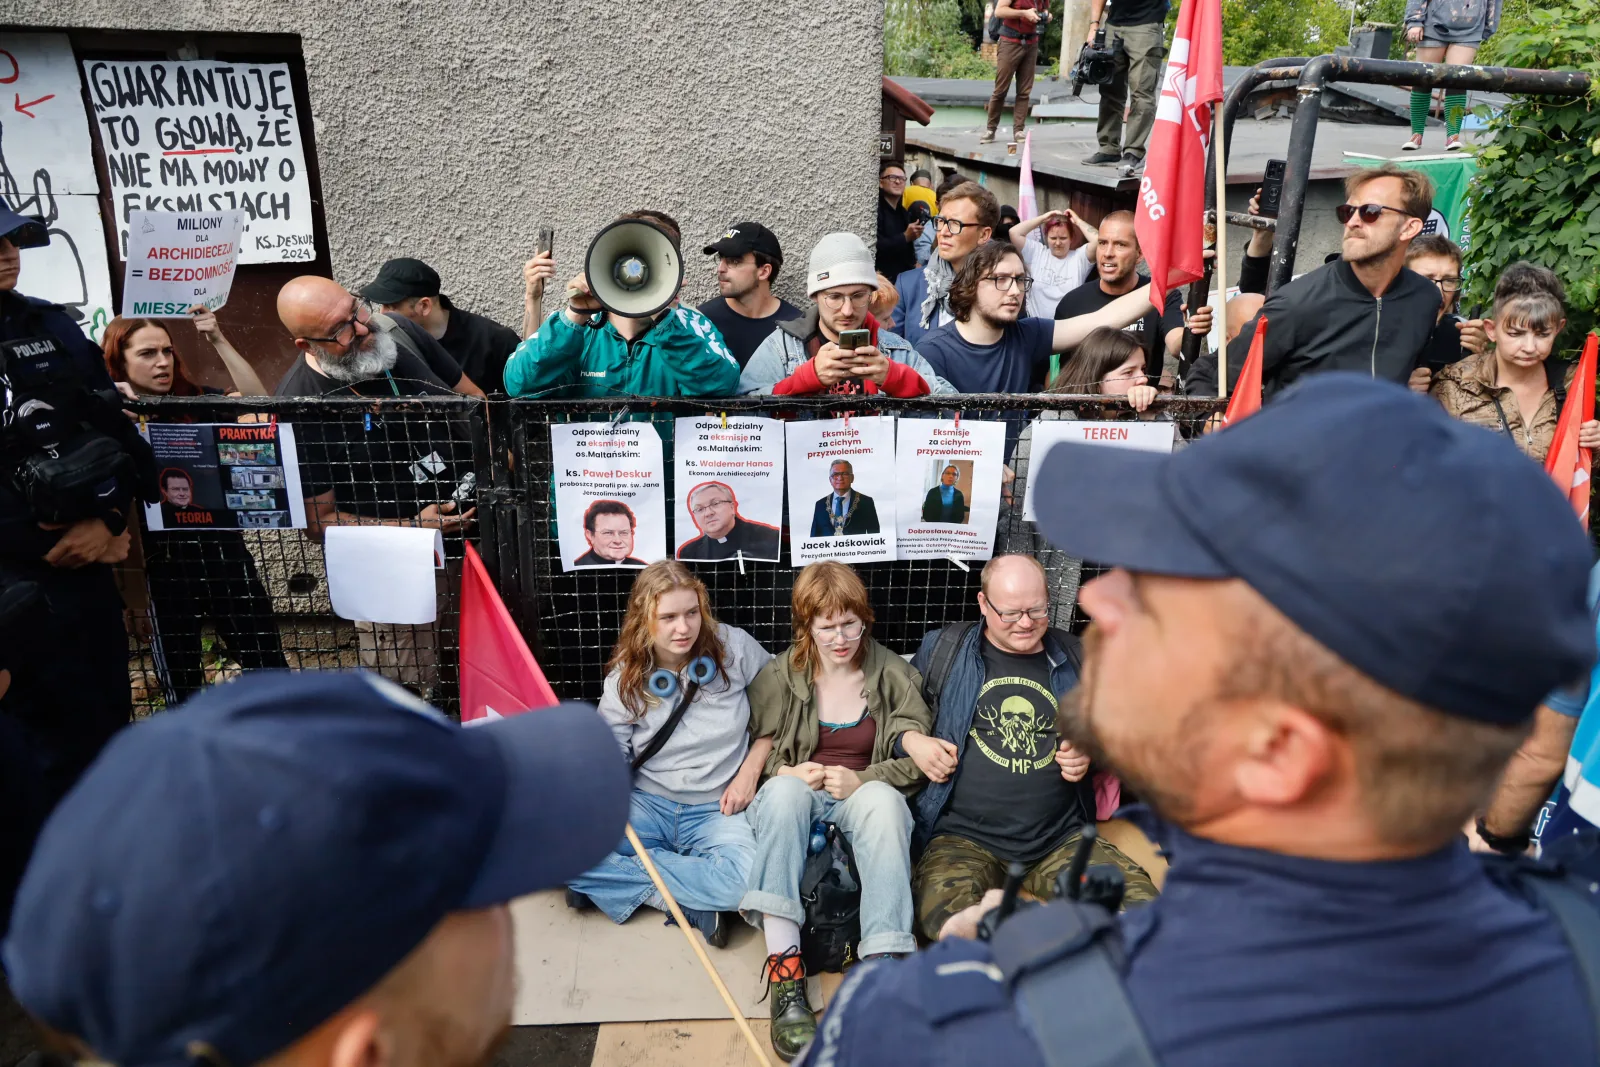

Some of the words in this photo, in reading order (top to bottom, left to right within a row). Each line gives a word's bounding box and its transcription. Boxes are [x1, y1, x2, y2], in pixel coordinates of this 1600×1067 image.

[101, 115, 140, 150] TO
[155, 112, 254, 154] GŁOWĄ,
[257, 114, 293, 147] ŻE
[108, 153, 152, 188] NIE
[160, 158, 198, 187] MA
[203, 156, 270, 186] MOWY
[279, 158, 296, 183] O
[177, 216, 223, 231] MILIONY
[195, 234, 209, 243] DLA
[280, 248, 311, 260] 2024
[148, 258, 235, 282] BEZDOMNOŚĆ
[193, 287, 207, 296] DLA
[12, 339, 57, 359] POLICJA
[580, 370, 606, 378] hummel
[219, 427, 276, 440] PRAKTYKA
[571, 428, 641, 437] Odpowiedzialny
[822, 428, 860, 438] Eksmisje
[932, 428, 970, 438] Eksmisje
[1082, 427, 1129, 440] TEREN
[588, 439, 626, 448] eksmisję
[710, 434, 749, 443] eksmisję
[829, 438, 862, 447] cichym
[939, 438, 971, 447] cichym
[807, 447, 874, 460] przyzwoleniem:
[916, 447, 983, 457] przyzwoleniem:
[685, 459, 698, 467] ks.
[699, 459, 745, 468] Waldemar
[746, 460, 774, 468] Hanas
[565, 469, 581, 477] ks.
[583, 469, 613, 478] Paweł
[615, 469, 652, 478] Deskur
[716, 470, 770, 478] Archidiecezjalny
[174, 511, 213, 524] TEORIA
[954, 529, 978, 537] Janas
[800, 540, 831, 550] Jacek
[832, 537, 887, 548] Jaśkowiak
[856, 548, 887, 556] Poznania
[1011, 757, 1032, 775] MF
